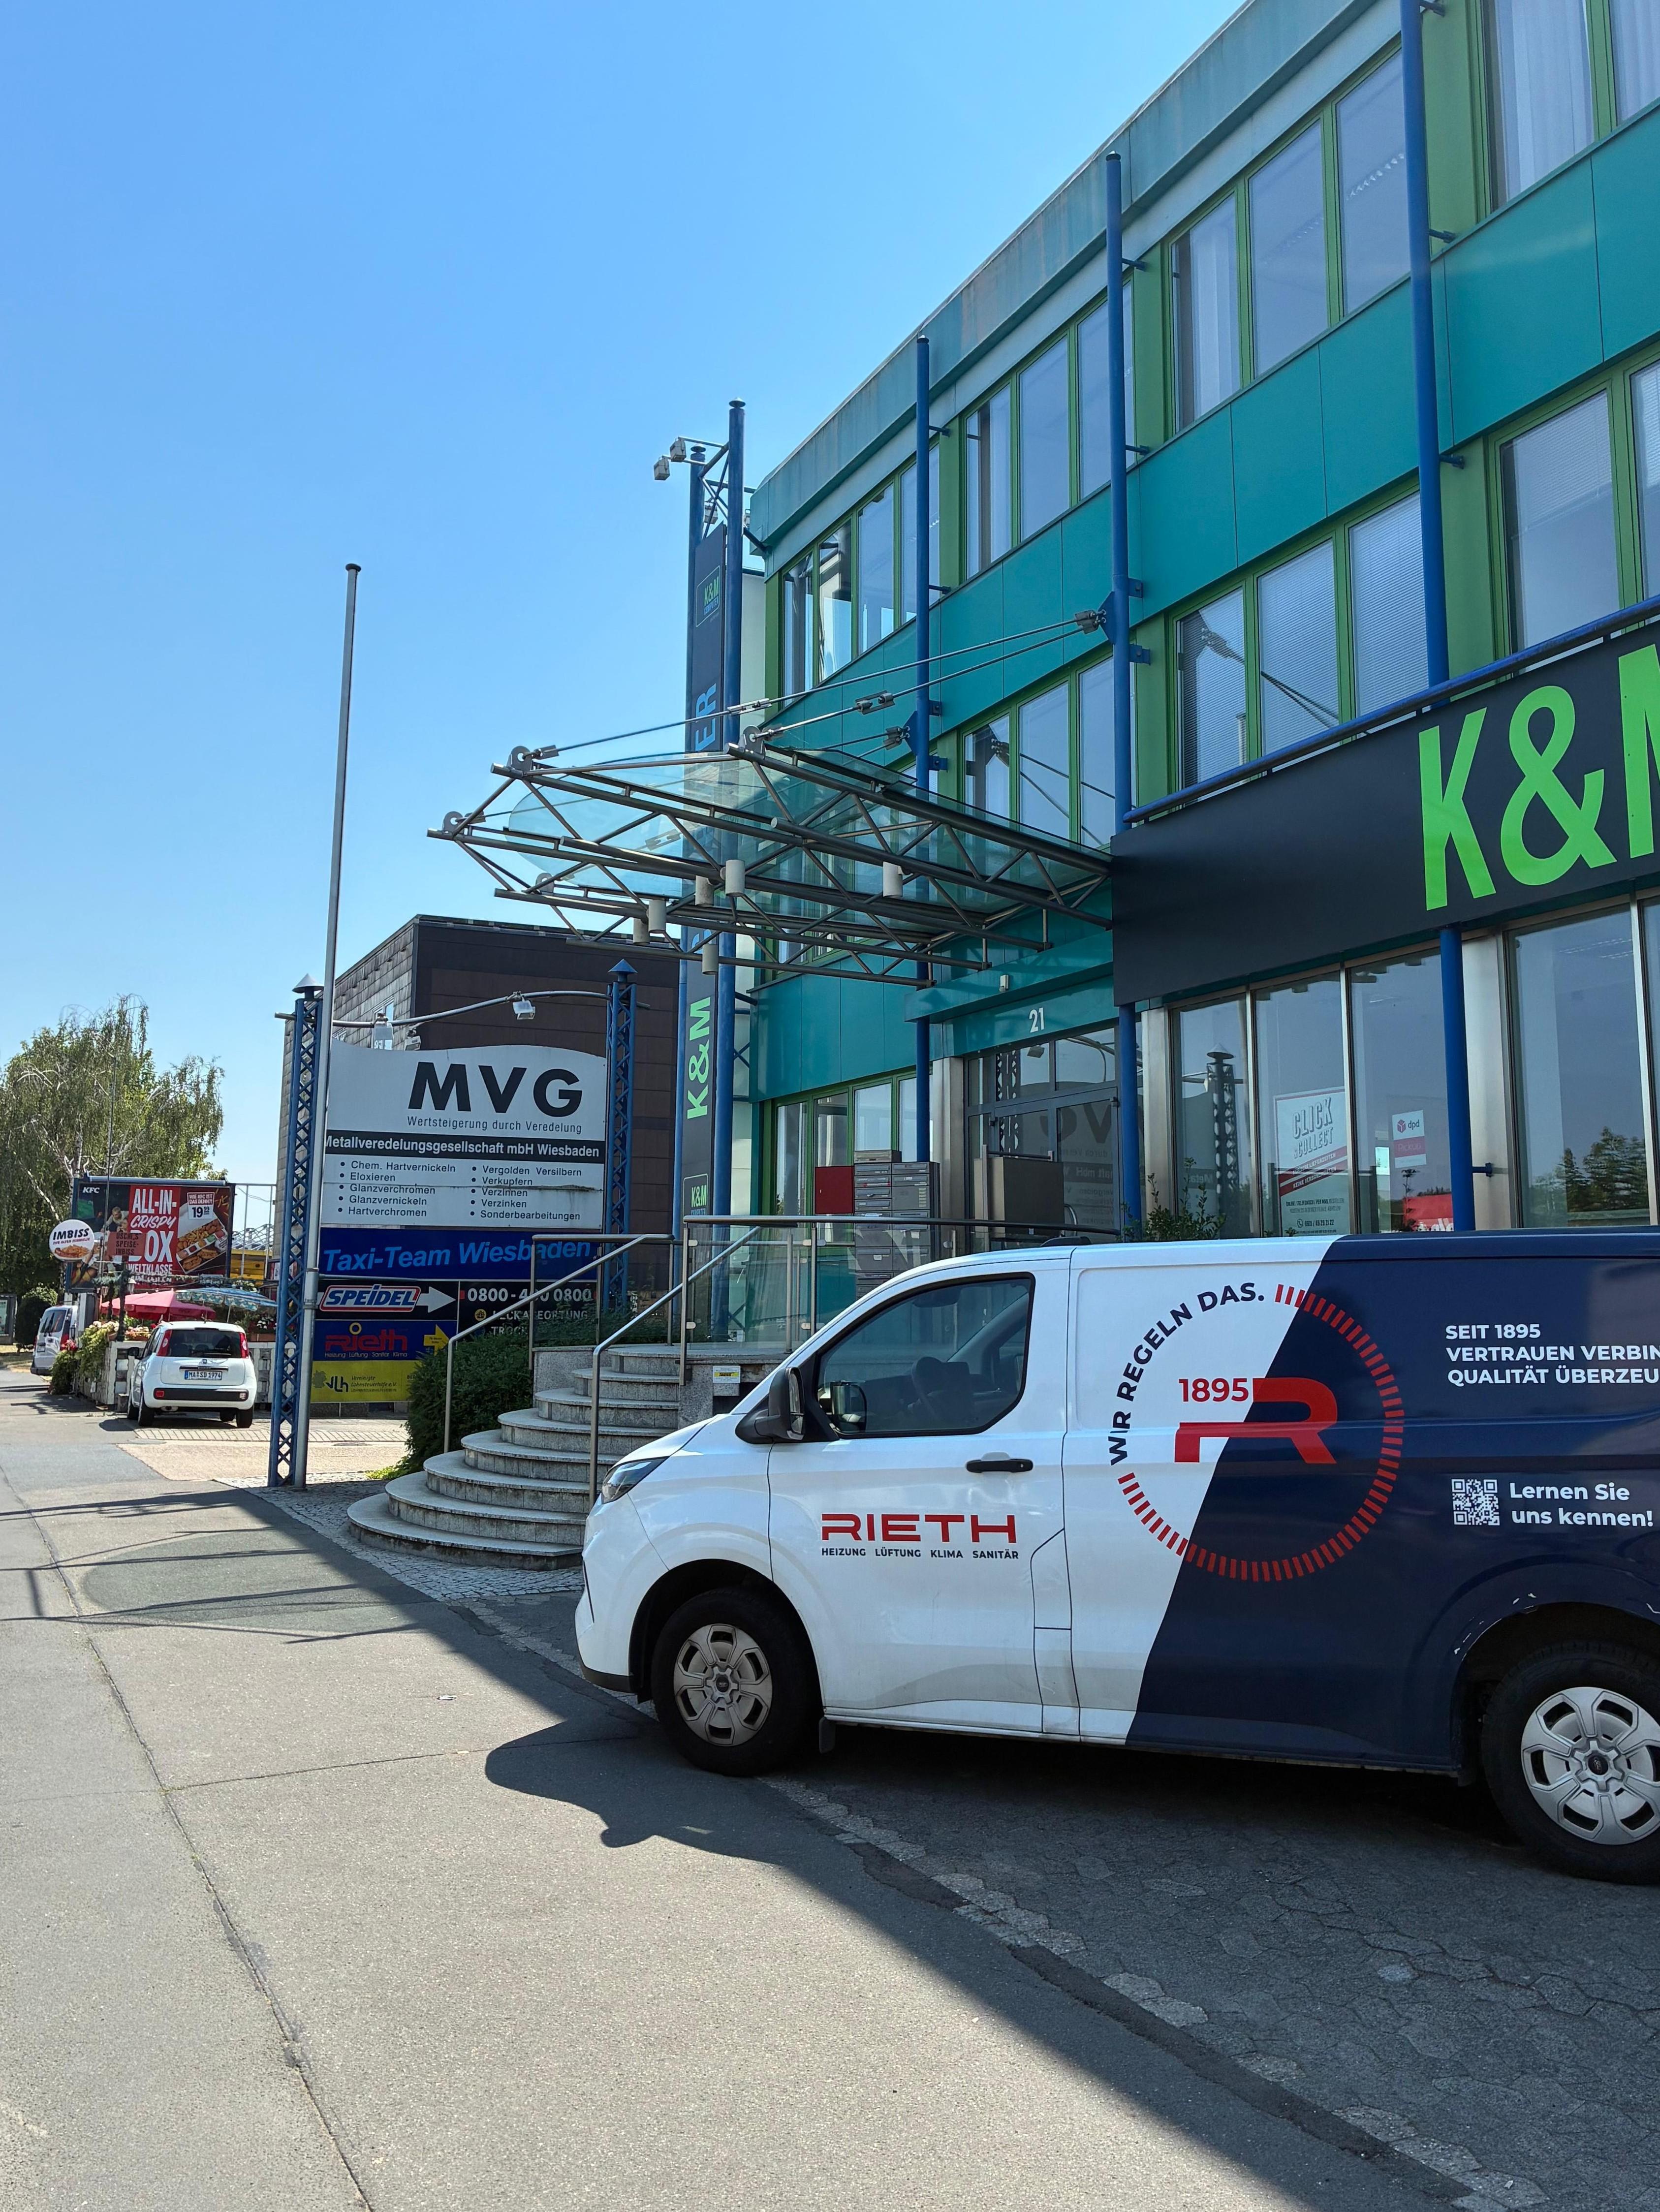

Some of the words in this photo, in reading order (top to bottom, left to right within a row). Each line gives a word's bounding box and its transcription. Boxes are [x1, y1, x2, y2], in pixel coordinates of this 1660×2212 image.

[704, 576, 719, 607] K&M
[1029, 1007, 1045, 1033] 21
[687, 996, 711, 1119] K&M
[408, 1061, 582, 1117] MVG
[407, 1116, 487, 1130] Wertsteigerung
[493, 1120, 521, 1130] durch
[526, 1121, 582, 1134] Veredelung
[1293, 1097, 1333, 1139] CLICK
[1408, 1120, 1420, 1130] dpd
[325, 1135, 504, 1154] Metallveredelungsgesellschaft
[507, 1143, 533, 1155] mbH
[537, 1143, 599, 1157] Wiesbaden
[351, 1160, 382, 1170] Chem.
[386, 1162, 455, 1172] Hartvernickeln
[483, 1165, 530, 1176] Vergolden
[536, 1167, 582, 1176] Versilbern
[350, 1172, 395, 1182] Eloxieren
[482, 1176, 532, 1187] Verkupfern
[350, 1183, 435, 1194] Glanzverchromen
[482, 1187, 528, 1197] Verzinnen
[691, 1184, 707, 1208] K&M
[132, 1188, 177, 1215] ALL-IN-
[349, 1195, 427, 1205] Glanzvernickeln
[481, 1199, 527, 1208] Verzinken
[348, 1207, 427, 1216] Hartverchromen
[480, 1210, 580, 1221] Sonderbearbeitungen
[130, 1215, 177, 1229] CRISPY
[53, 1228, 90, 1241] IMBISS
[128, 1230, 174, 1262] OX
[324, 1246, 450, 1271] Taxi-Team
[459, 1240, 590, 1264] Wiesbaden
[128, 1264, 173, 1275] WELTKLASSE
[468, 1288, 508, 1302] 0800
[519, 1288, 549, 1302] 40
[553, 1288, 592, 1302] 0800
[1197, 1282, 1264, 1312] DAS.
[325, 1322, 408, 1351] Rieth
[1445, 1325, 1489, 1340] SEIT
[1495, 1324, 1541, 1339] 1895
[1117, 1303, 1193, 1402] REGELN
[1446, 1346, 1574, 1362] VERTRAUEN
[1580, 1345, 1660, 1361] VERBIN
[1447, 1365, 1549, 1387] QUALITÄT
[1556, 1365, 1659, 1384] ÜBERZEU
[1179, 1378, 1250, 1402] 1895
[1108, 1411, 1131, 1465] WIR
[1509, 1483, 1588, 1500] Lernen
[1595, 1482, 1630, 1500] Sie
[1512, 1510, 1552, 1524] uns
[1558, 1508, 1654, 1527] kennen!
[821, 1514, 1016, 1543] RIETH
[821, 1548, 866, 1557] HEIZUNG
[875, 1547, 921, 1558] LÜFTUNG
[931, 1550, 963, 1558] KLIMA
[972, 1548, 1019, 1559] SANITÄR
